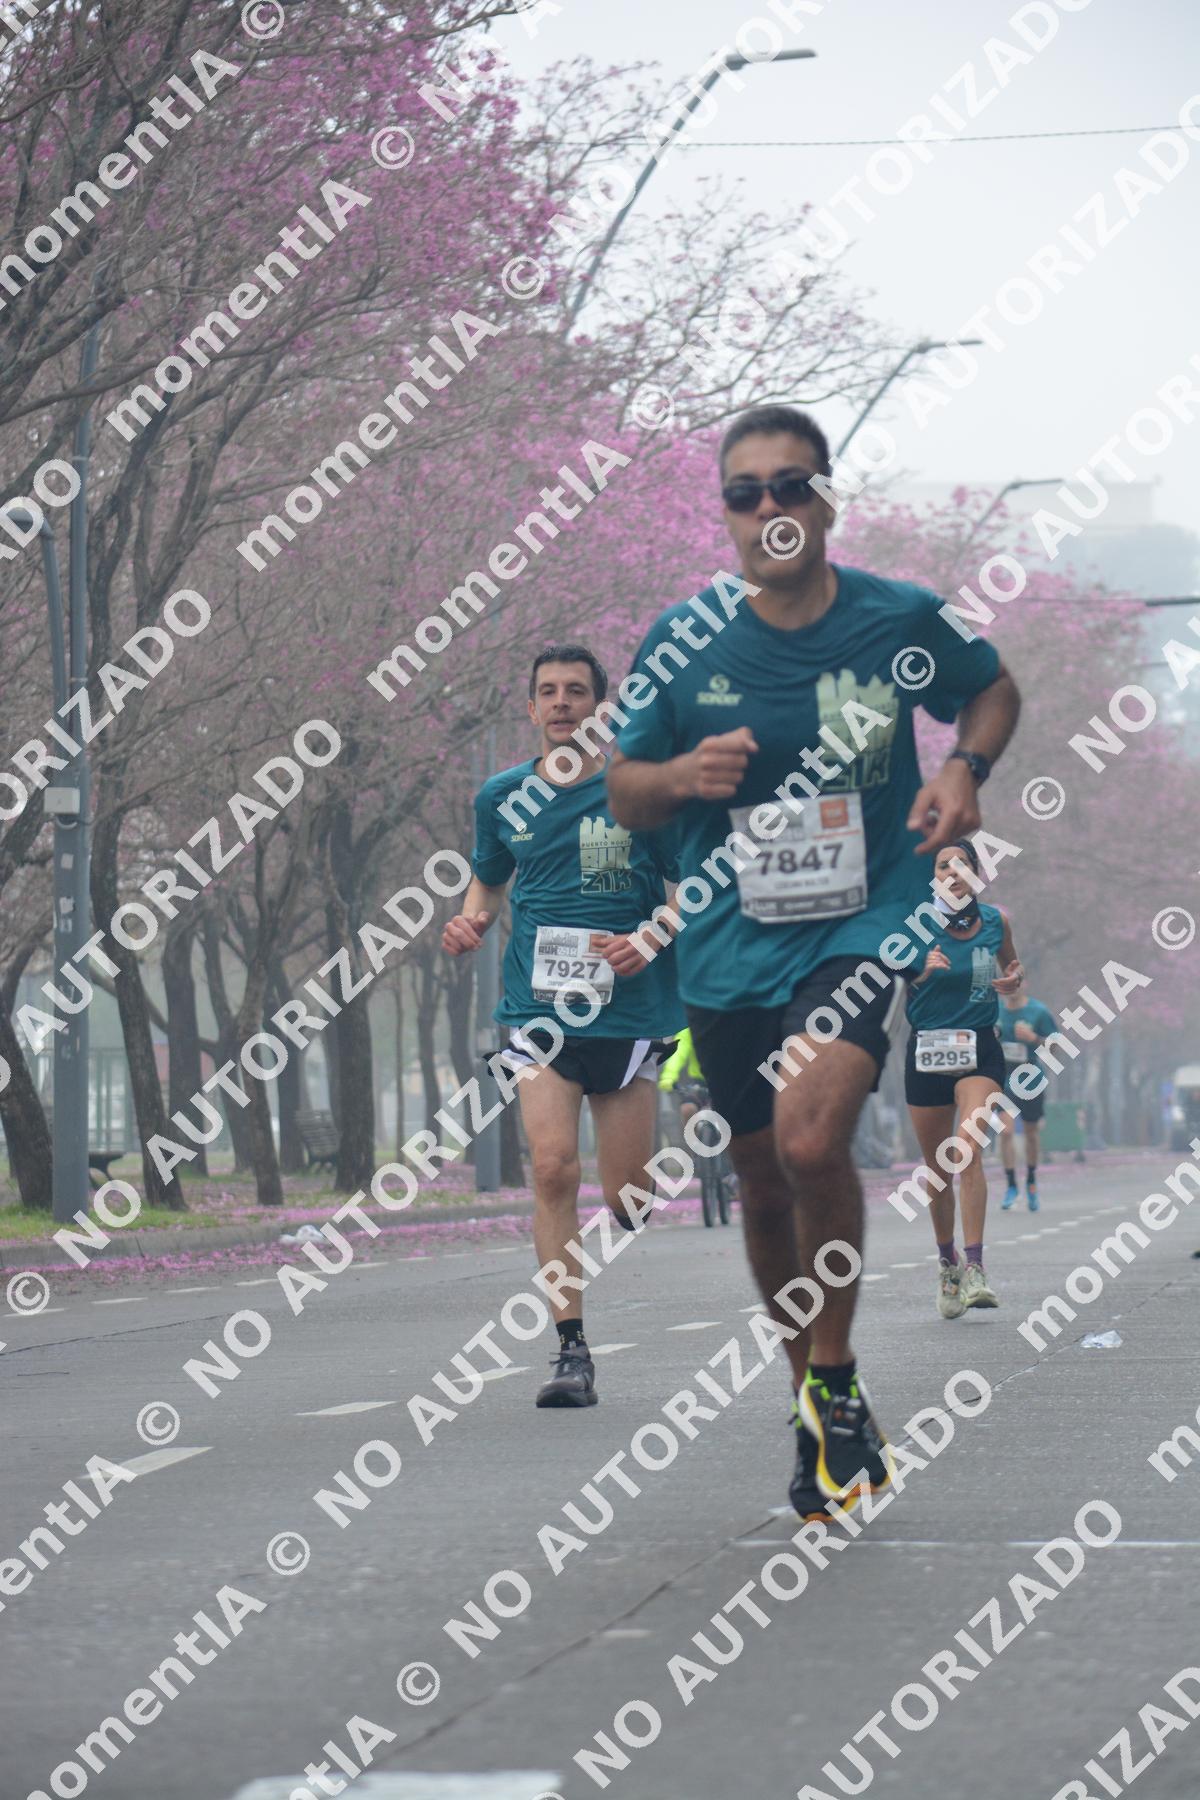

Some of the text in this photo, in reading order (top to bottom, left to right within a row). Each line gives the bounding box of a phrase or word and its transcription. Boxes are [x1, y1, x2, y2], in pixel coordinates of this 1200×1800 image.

[757, 842, 843, 875] 7847
[544, 959, 600, 979] 7927
[921, 1051, 971, 1066] 8295
